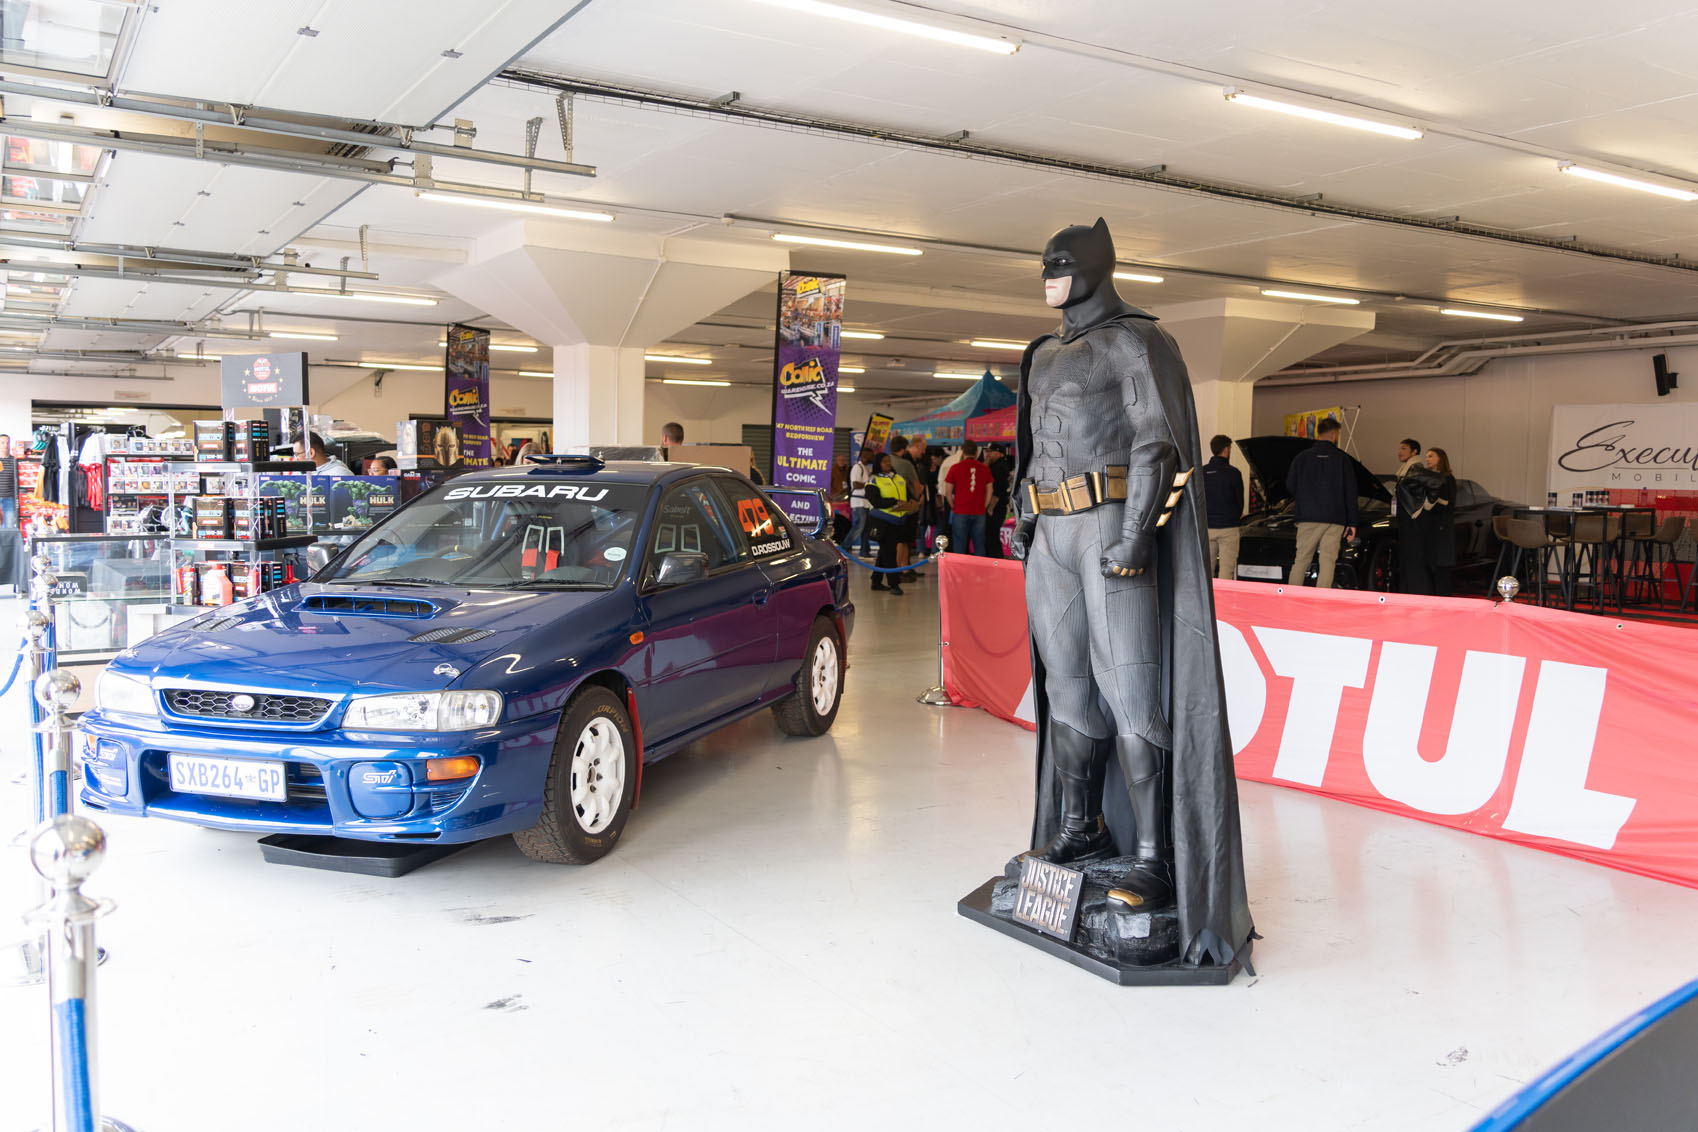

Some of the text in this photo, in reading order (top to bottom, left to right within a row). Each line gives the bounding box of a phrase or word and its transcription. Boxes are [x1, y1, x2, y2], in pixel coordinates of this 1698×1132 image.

[780, 360, 823, 386] Comic
[797, 447, 813, 456] THE
[463, 457, 489, 466] IMATE
[777, 455, 828, 471] ULTIMATE
[785, 472, 817, 484] COMIC,
[1611, 472, 1697, 483] MOBIL
[443, 484, 610, 501] SUBARU
[300, 496, 326, 505] HULK
[369, 496, 394, 505] HULK
[790, 500, 811, 510] AND
[751, 539, 791, 557] D.ROSSOUW
[175, 760, 280, 794] SXB264 GP
[1021, 858, 1077, 903] JUSTICE
[1015, 887, 1071, 935] LEAGUE
